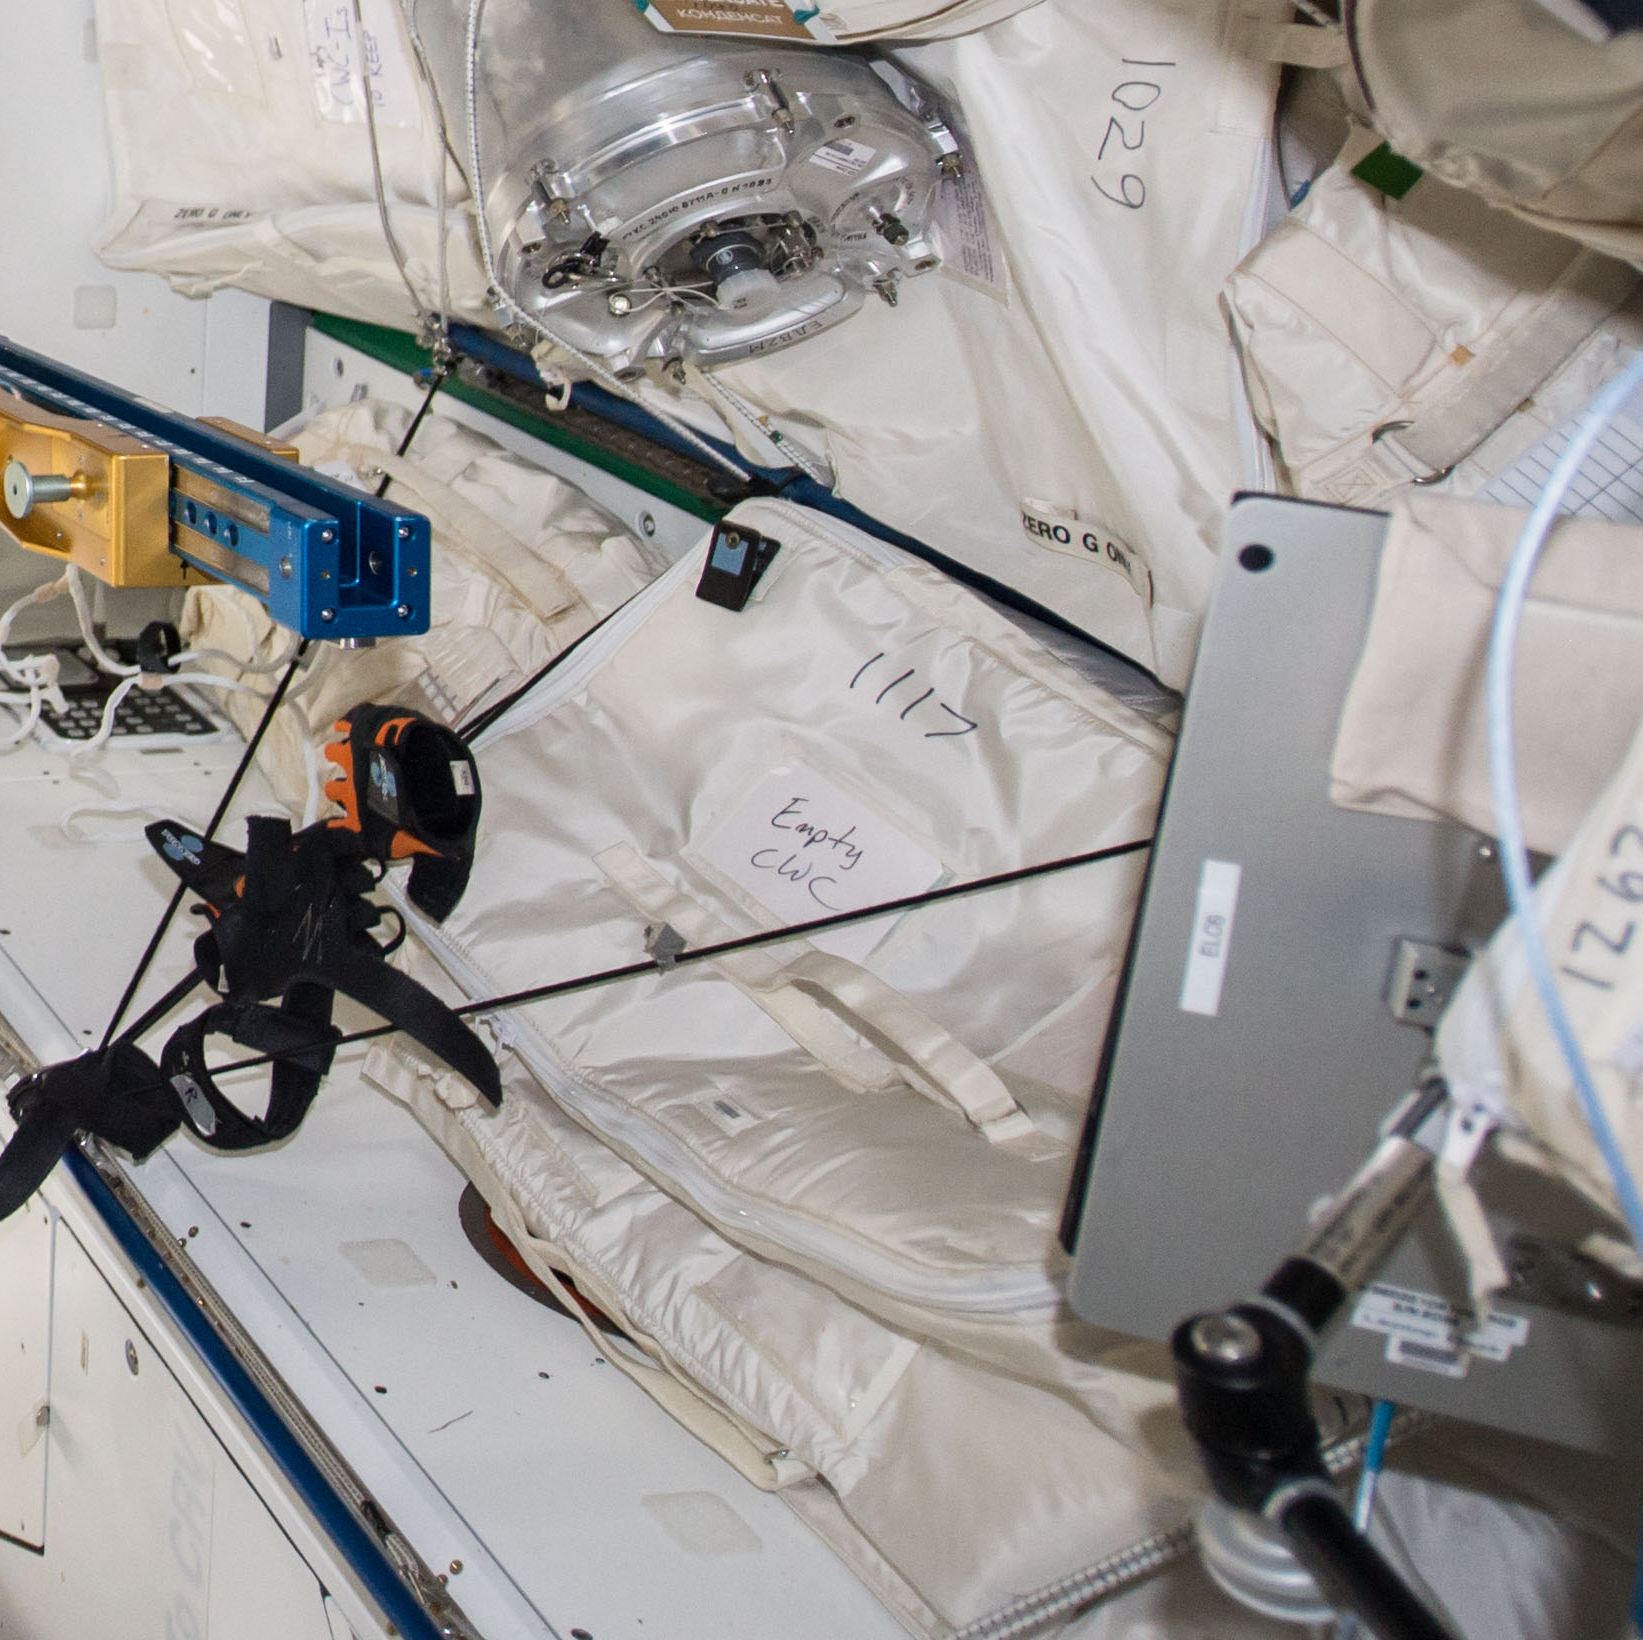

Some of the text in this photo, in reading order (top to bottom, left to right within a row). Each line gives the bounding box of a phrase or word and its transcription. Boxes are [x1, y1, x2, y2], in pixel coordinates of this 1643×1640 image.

[676, 8, 783, 27] КОНДЕНСАТ
[1092, 58, 1176, 211] 1029
[1082, 533, 1100, 554] G
[849, 652, 979, 739] 1117
[770, 795, 865, 867] Empty
[750, 850, 853, 912] CWC
